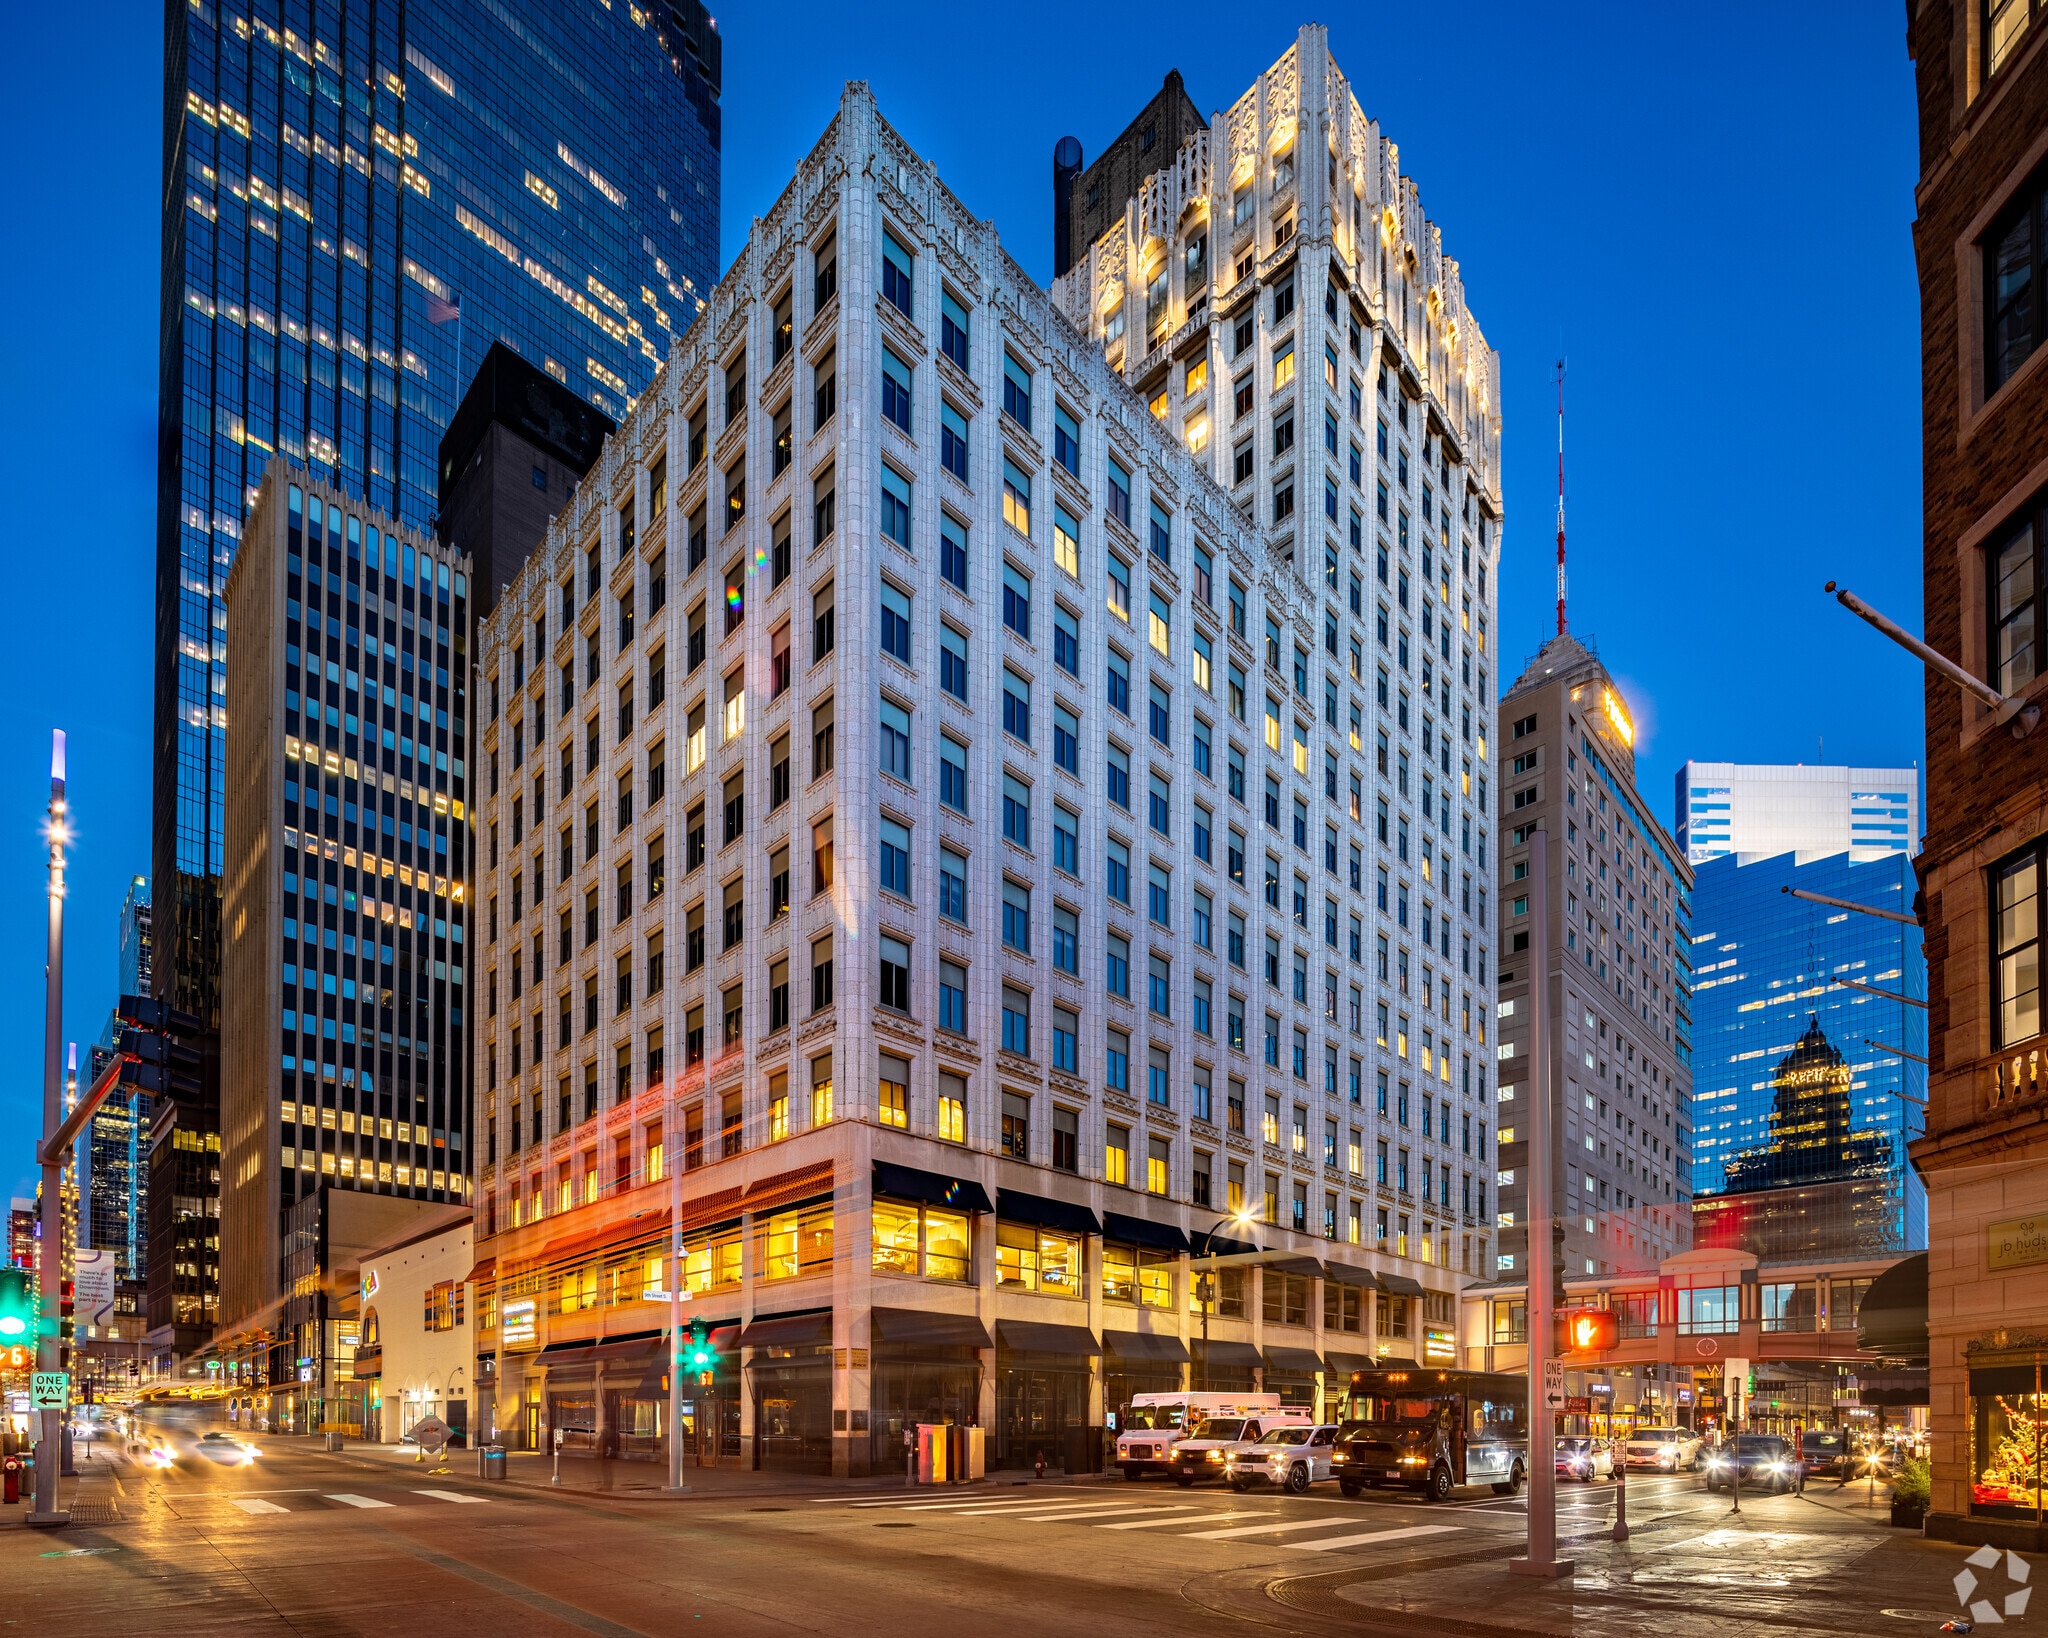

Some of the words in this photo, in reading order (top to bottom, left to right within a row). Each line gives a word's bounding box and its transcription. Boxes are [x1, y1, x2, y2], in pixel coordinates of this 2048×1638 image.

[1997, 1239, 2012, 1258] jb
[2016, 1233, 2047, 1250] huds
[11, 1347, 23, 1365] 6
[1546, 1362, 1561, 1375] ONE
[36, 1375, 63, 1385] ONE
[1545, 1377, 1562, 1389] WAY
[35, 1386, 63, 1395] WAY
